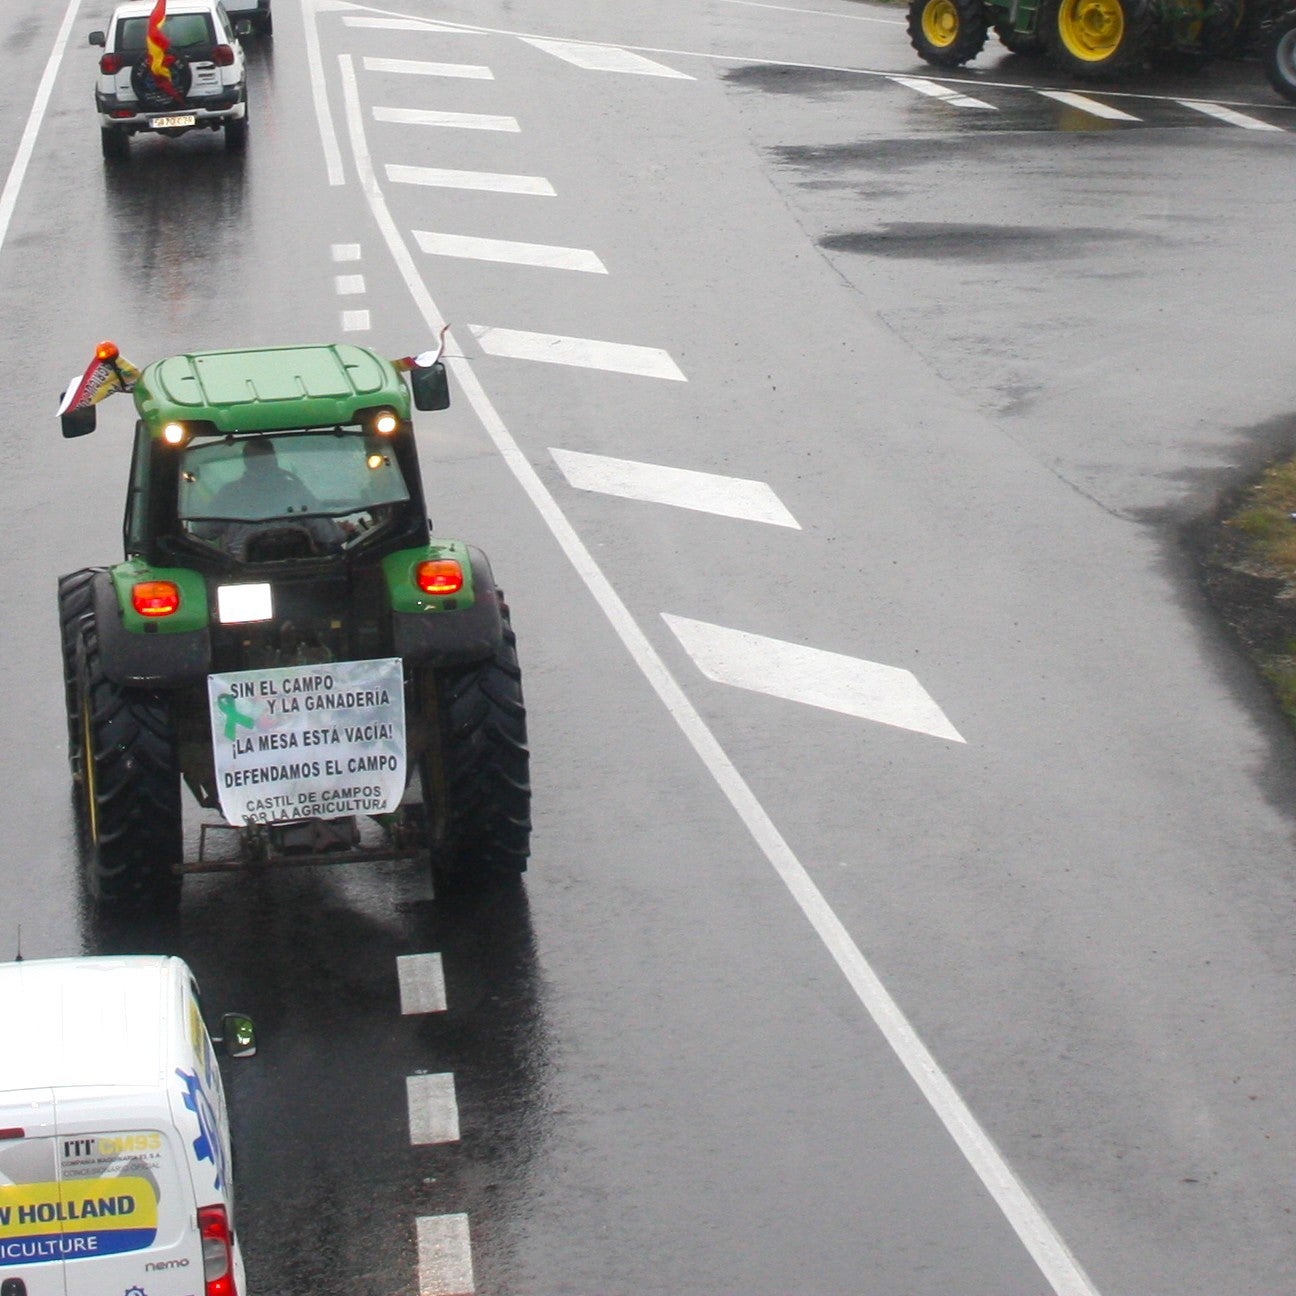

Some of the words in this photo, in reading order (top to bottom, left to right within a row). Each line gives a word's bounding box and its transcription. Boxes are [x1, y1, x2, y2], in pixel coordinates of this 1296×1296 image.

[230, 681, 254, 699] SIN
[260, 679, 278, 696] EL
[282, 674, 334, 694] CAMPO
[266, 699, 277, 715] Y
[281, 697, 300, 713] LA
[305, 687, 390, 711] GANADERÍA
[232, 737, 254, 759] ¡LA
[258, 732, 298, 751] MESA
[303, 727, 341, 747] ESTÁ
[345, 722, 393, 743] VACÍA!
[225, 761, 321, 788] DEFENDAMOS
[325, 759, 343, 776] EL
[347, 755, 398, 773] CAMPO
[246, 794, 295, 812] CASTIL
[298, 792, 318, 804] DE
[321, 785, 382, 802] CAMPOS
[271, 808, 290, 821] LA
[292, 799, 388, 819] AGRICULTURA
[18, 1195, 135, 1224] HOLLAND
[145, 1257, 190, 1272] nemo
